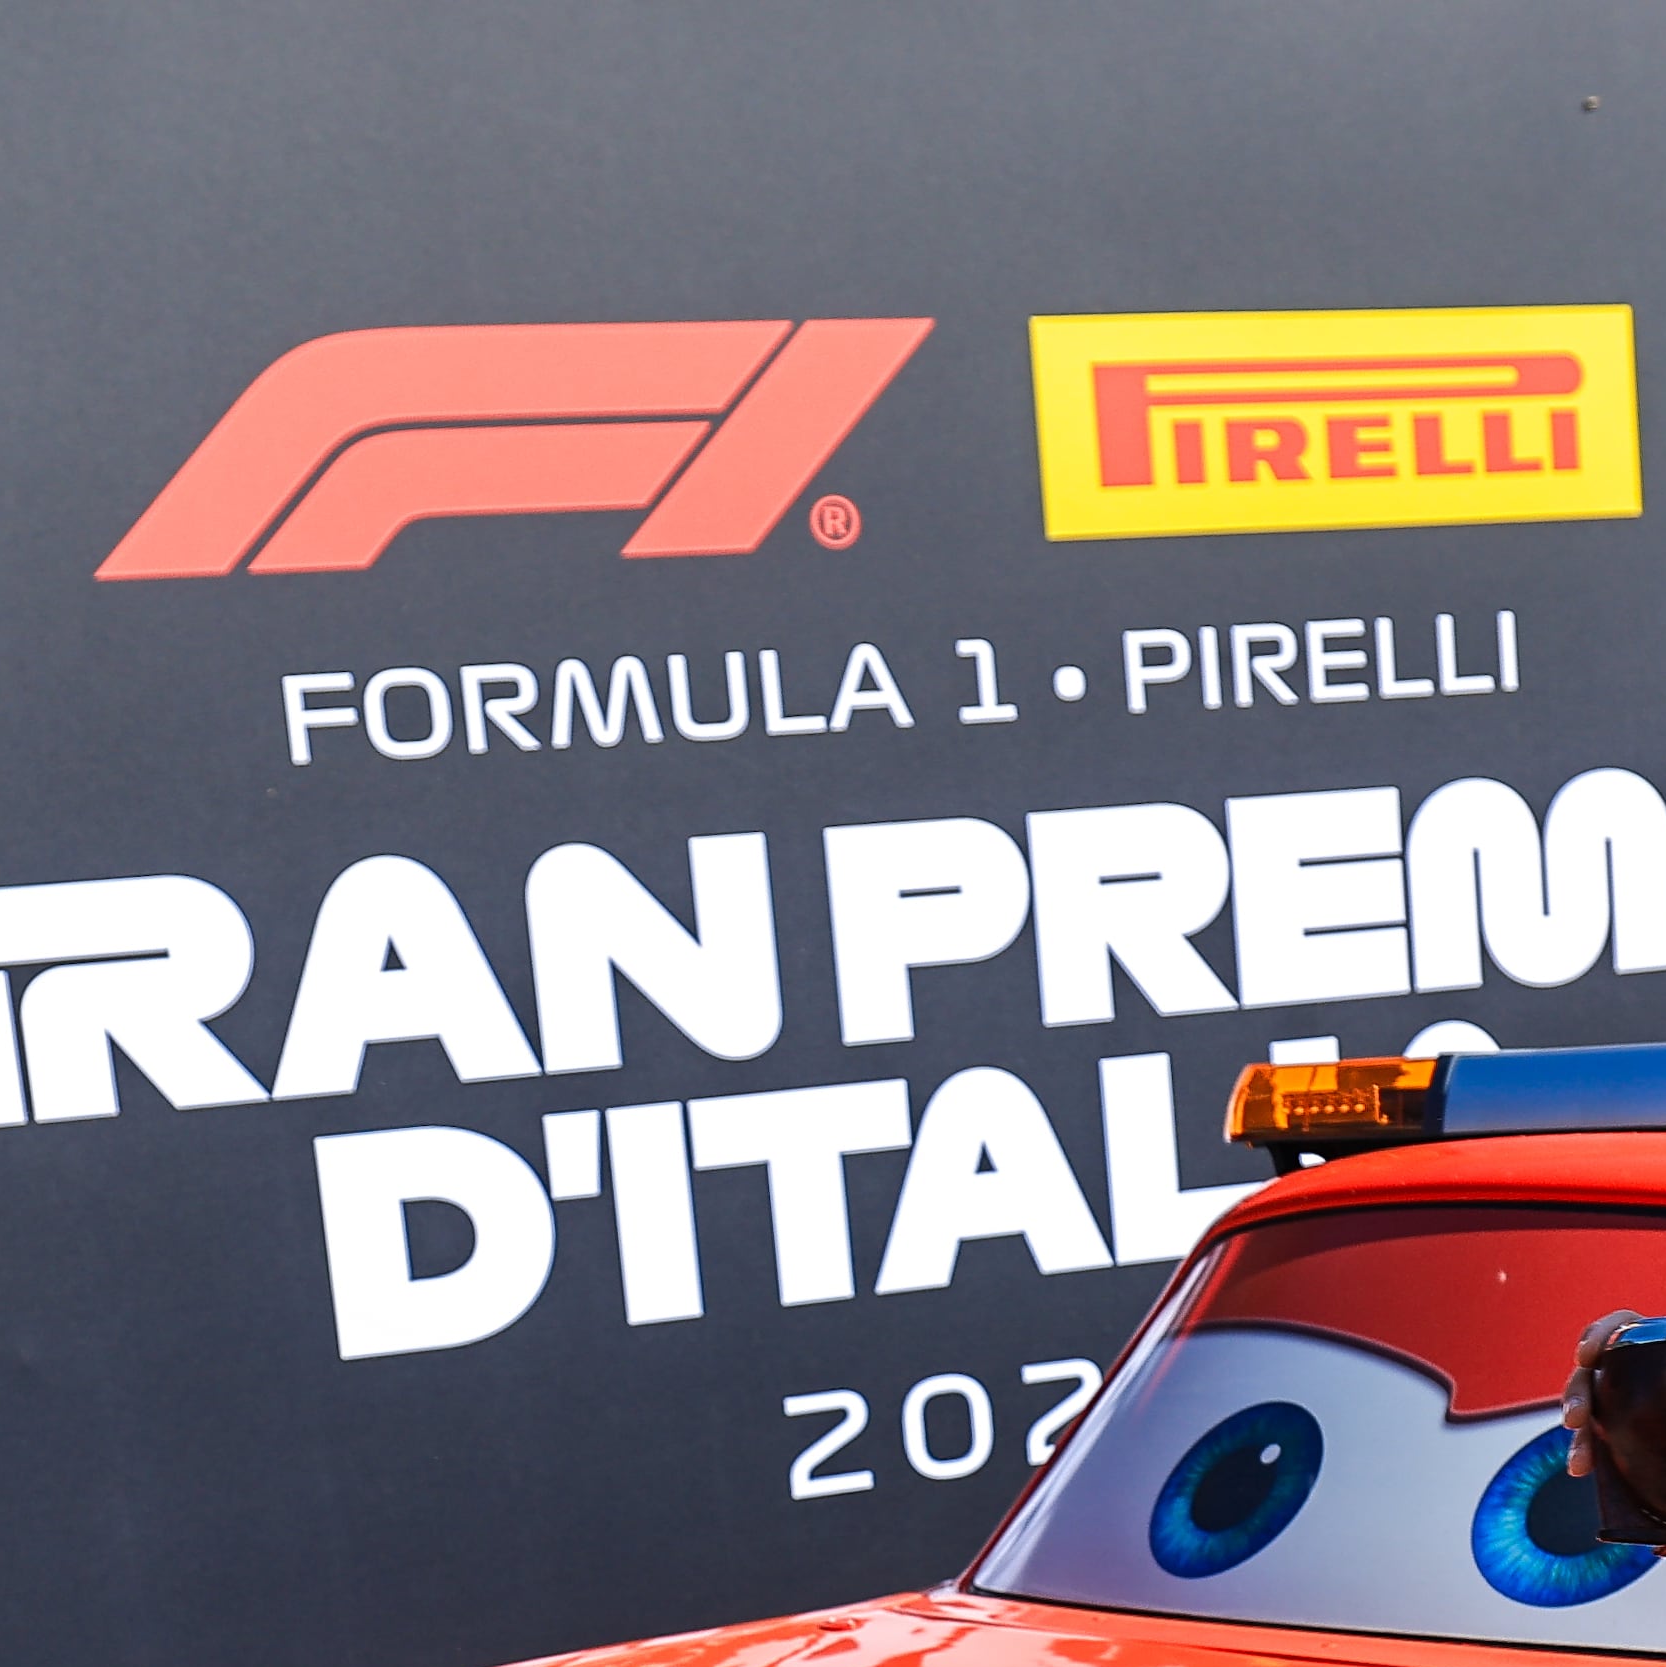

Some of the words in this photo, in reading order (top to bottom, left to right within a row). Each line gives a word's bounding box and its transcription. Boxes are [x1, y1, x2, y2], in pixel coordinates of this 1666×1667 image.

[1092, 354, 1583, 488] PIRELLI
[281, 642, 915, 766] FORMULA
[955, 638, 1019, 725] 1
[1122, 609, 1520, 715] PIRELLI
[312, 1020, 1501, 1361] D'ITAL
[782, 1357, 1103, 1500] 202
